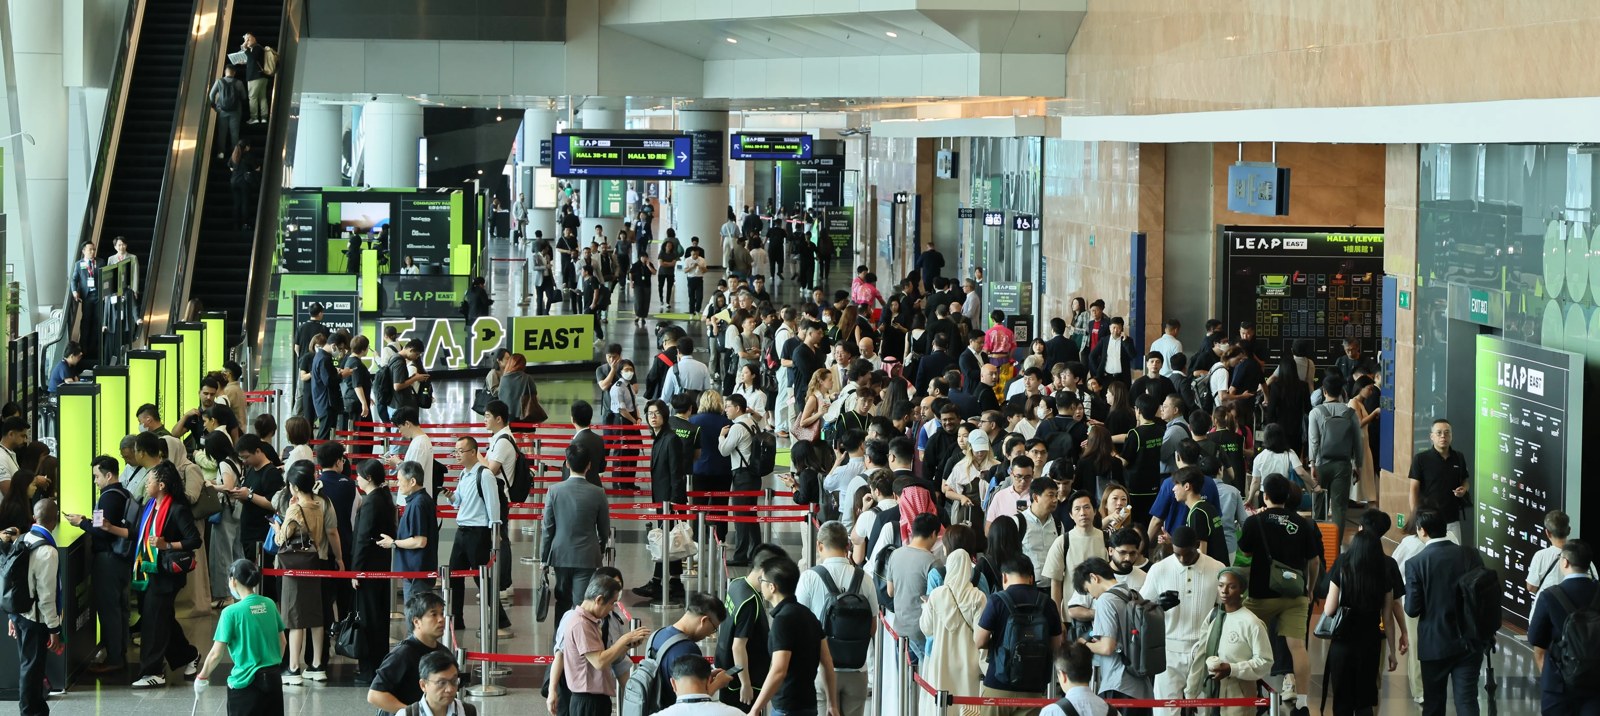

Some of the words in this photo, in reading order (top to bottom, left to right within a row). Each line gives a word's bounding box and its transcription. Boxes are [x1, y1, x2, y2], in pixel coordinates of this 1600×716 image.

[1235, 238, 1281, 250] LEAP
[1355, 235, 1383, 243] (LEVEL
[394, 291, 434, 301] LEAP
[1472, 298, 1480, 312] EXIT
[524, 327, 584, 351] EAST
[1498, 361, 1527, 390] LEAP
[1530, 376, 1542, 388] EAST
